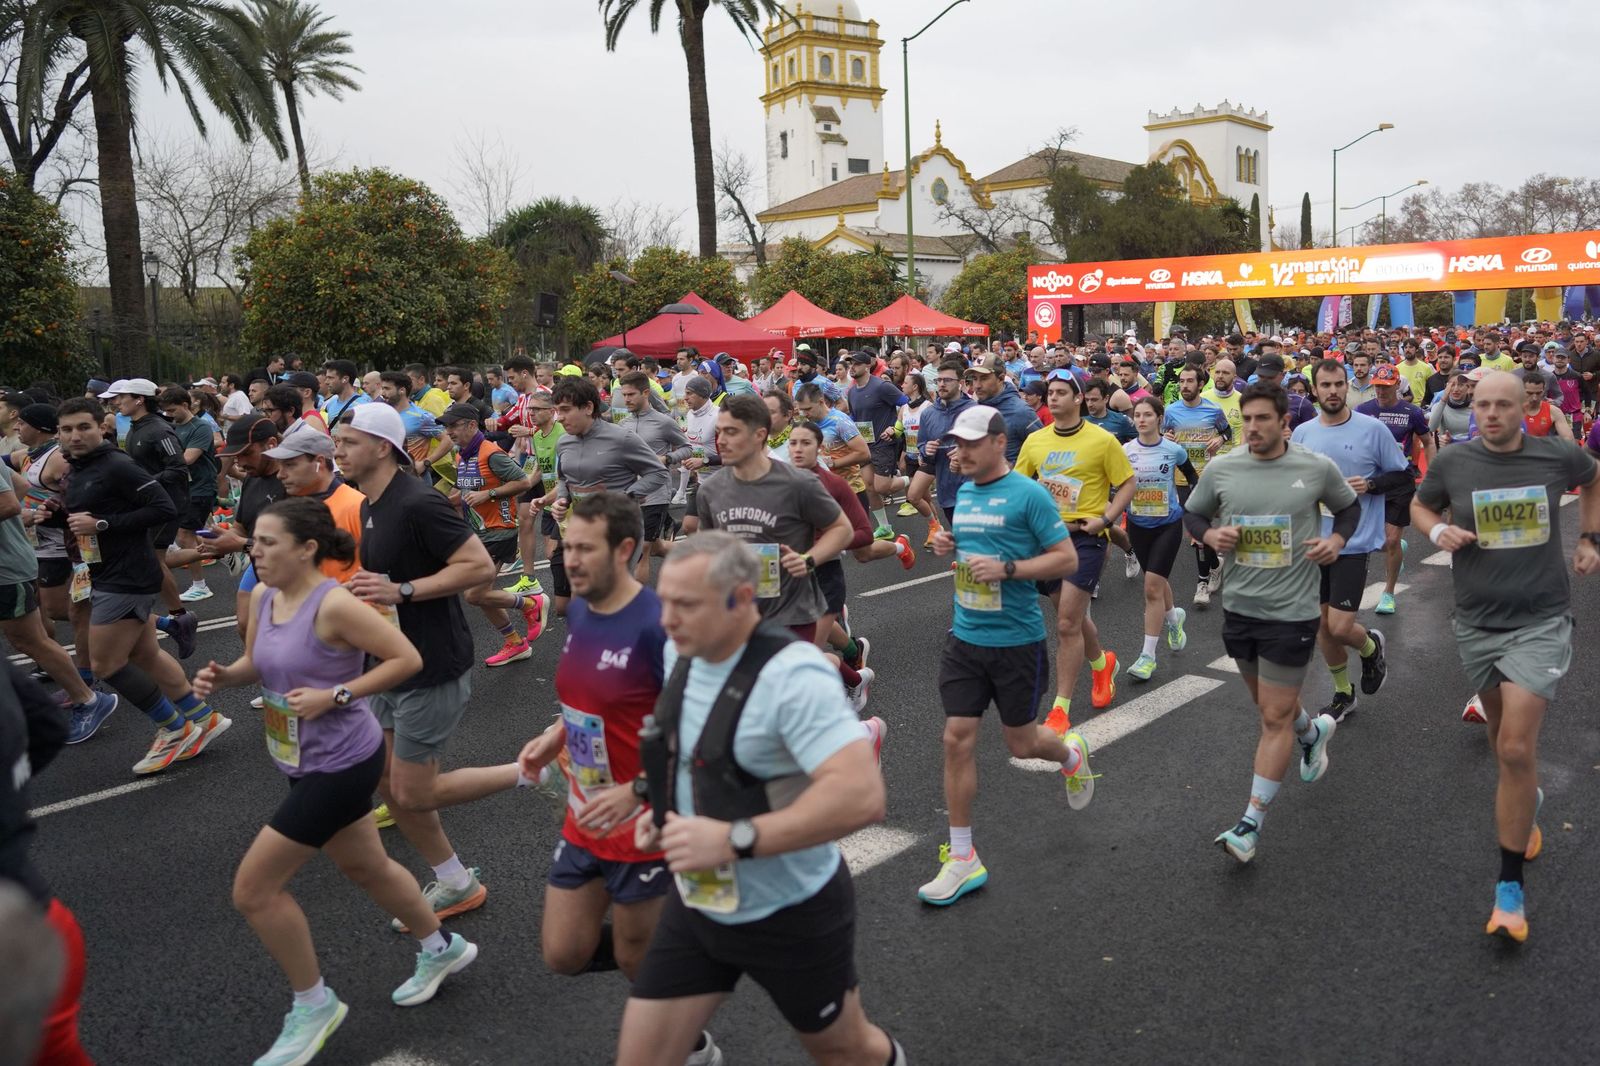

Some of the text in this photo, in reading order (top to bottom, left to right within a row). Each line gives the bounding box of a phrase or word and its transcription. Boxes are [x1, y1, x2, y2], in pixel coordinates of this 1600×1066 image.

[1448, 254, 1504, 272] HOKA
[1515, 263, 1557, 272] HYUNDAI
[1181, 270, 1225, 287] HOKA
[1306, 270, 1361, 285] sevilla
[1145, 281, 1175, 290] HYUNDAI
[1394, 417, 1409, 425] RUN
[1046, 451, 1076, 466] RUN
[456, 478, 484, 487] STOLFI
[728, 506, 778, 528] ENFORMA
[1481, 502, 1537, 523] 10427
[1239, 529, 1282, 545] 10363
[568, 727, 588, 755] 45
